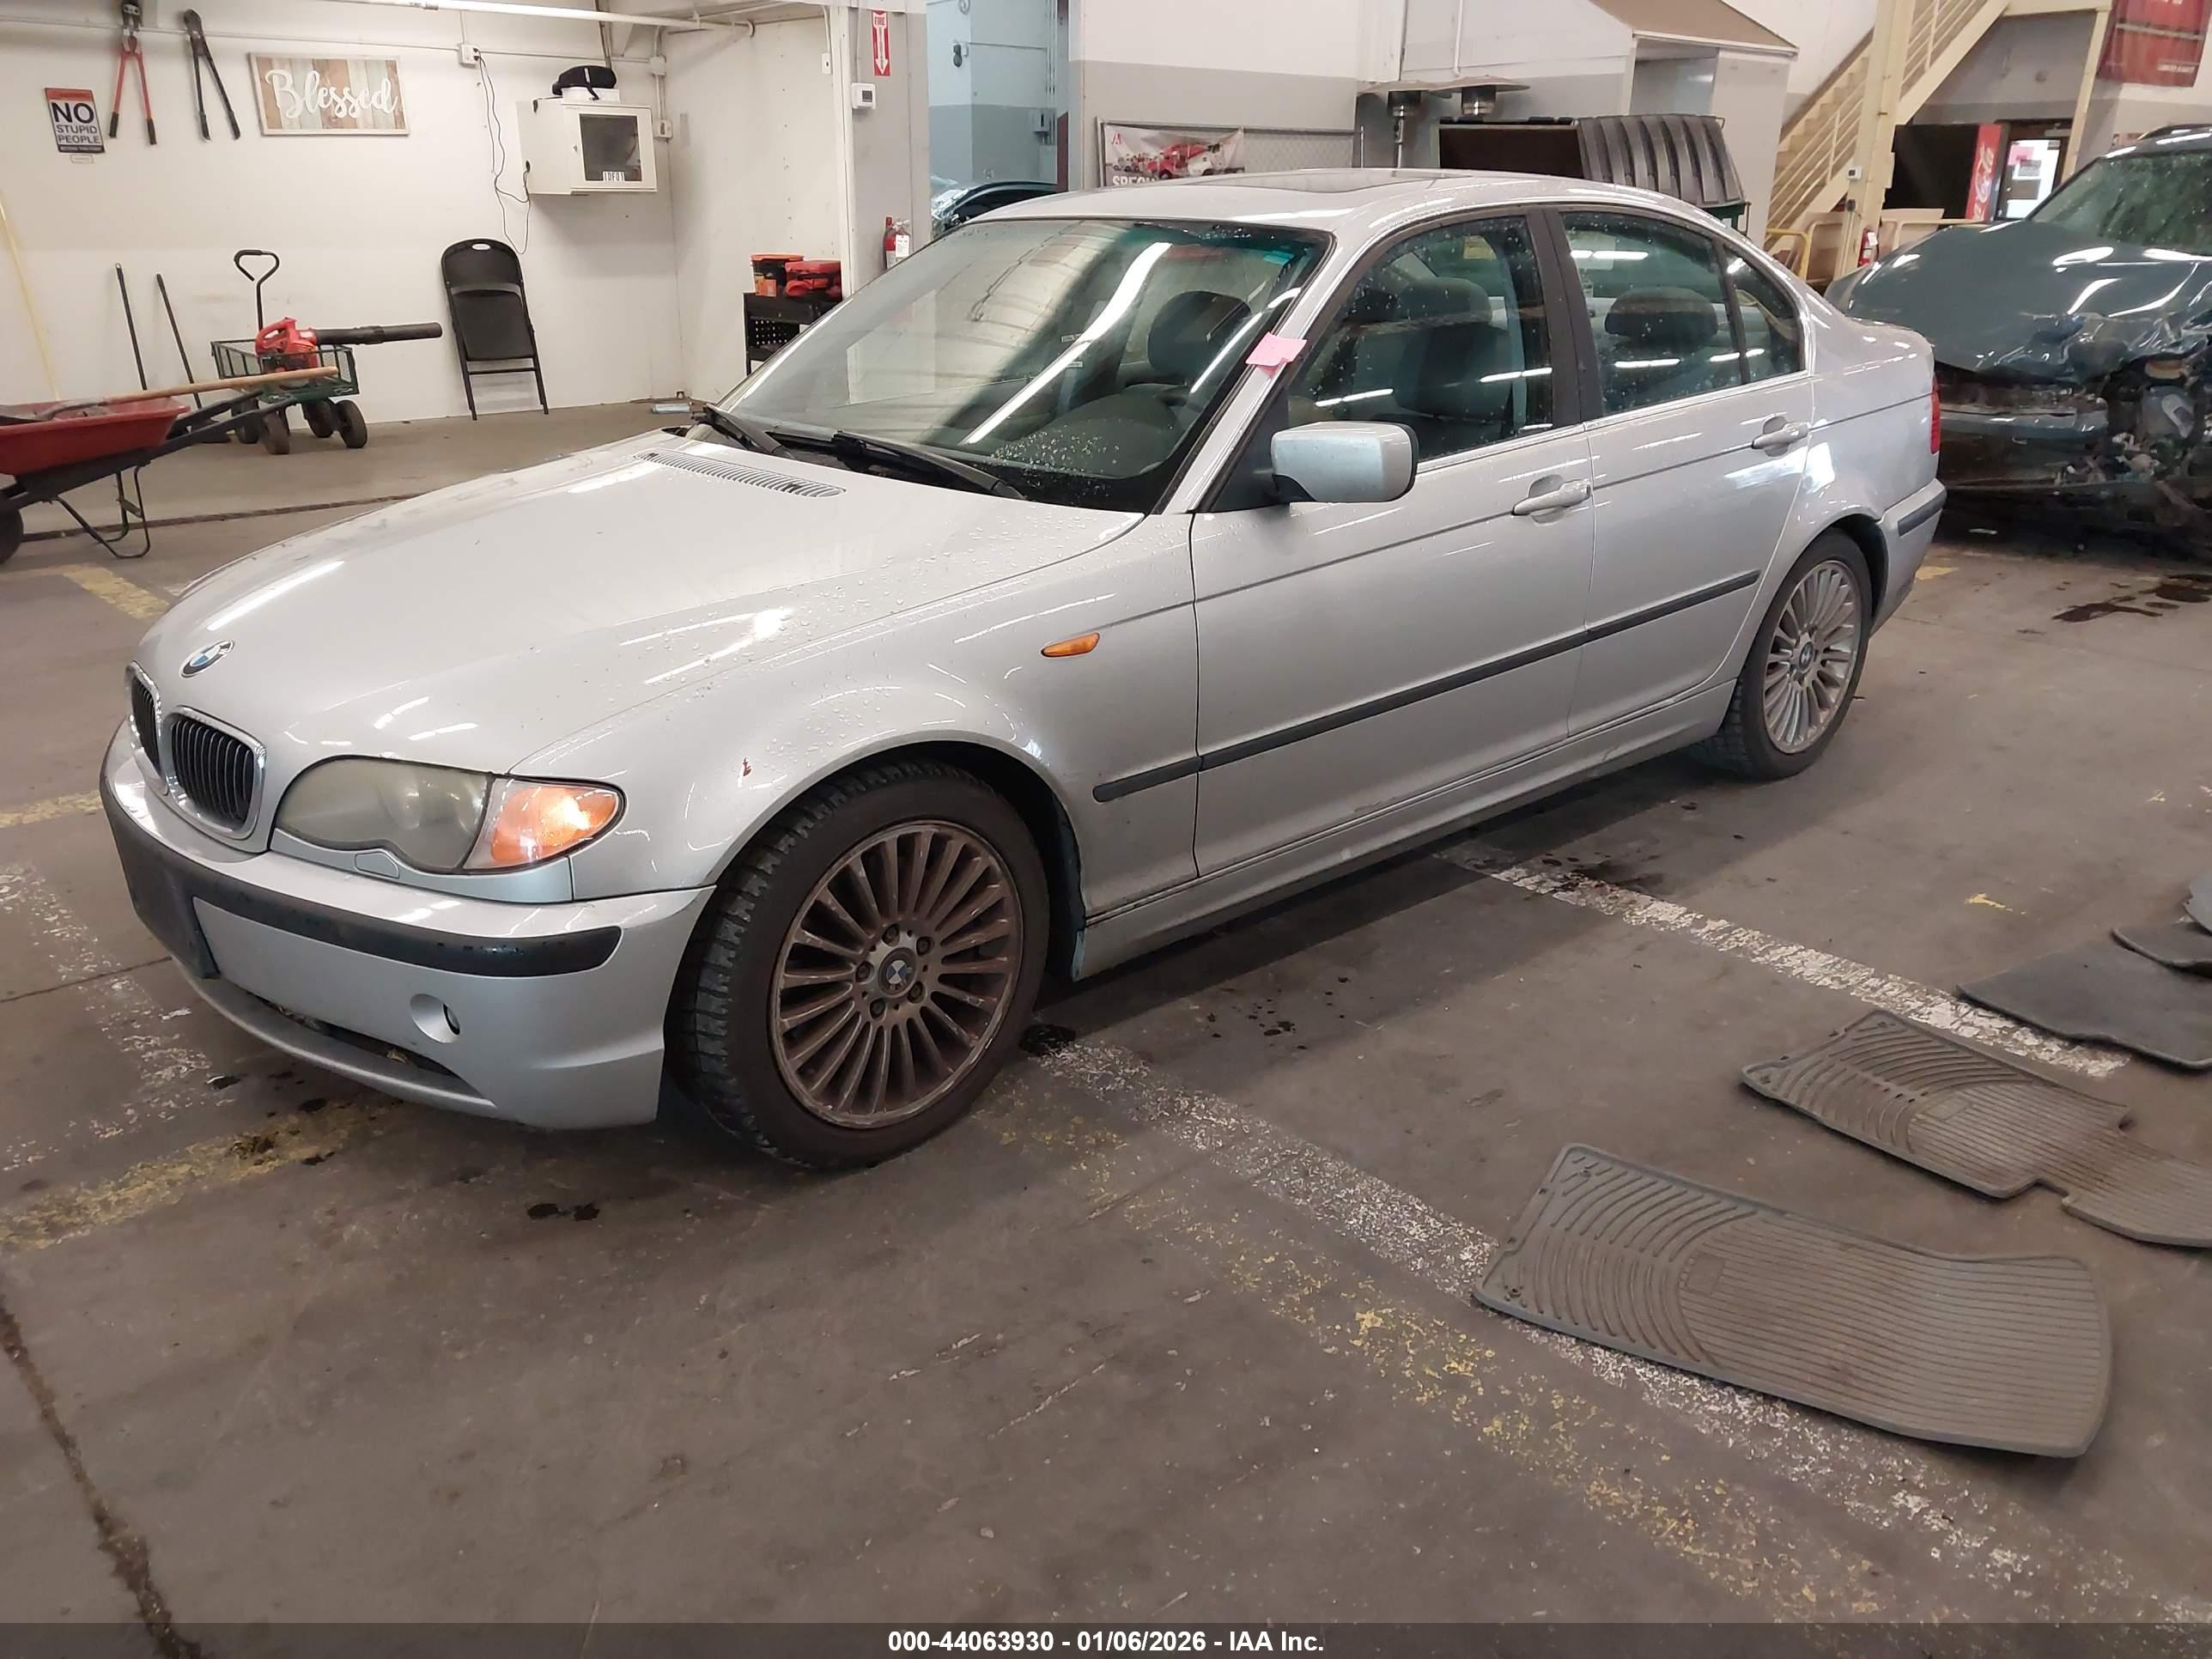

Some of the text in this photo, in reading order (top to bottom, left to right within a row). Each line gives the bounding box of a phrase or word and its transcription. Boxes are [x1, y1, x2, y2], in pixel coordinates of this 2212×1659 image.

[264, 69, 398, 118] Blessed
[52, 102, 94, 124] NO
[56, 124, 98, 134] STUPID
[58, 134, 101, 144] PEOPLE
